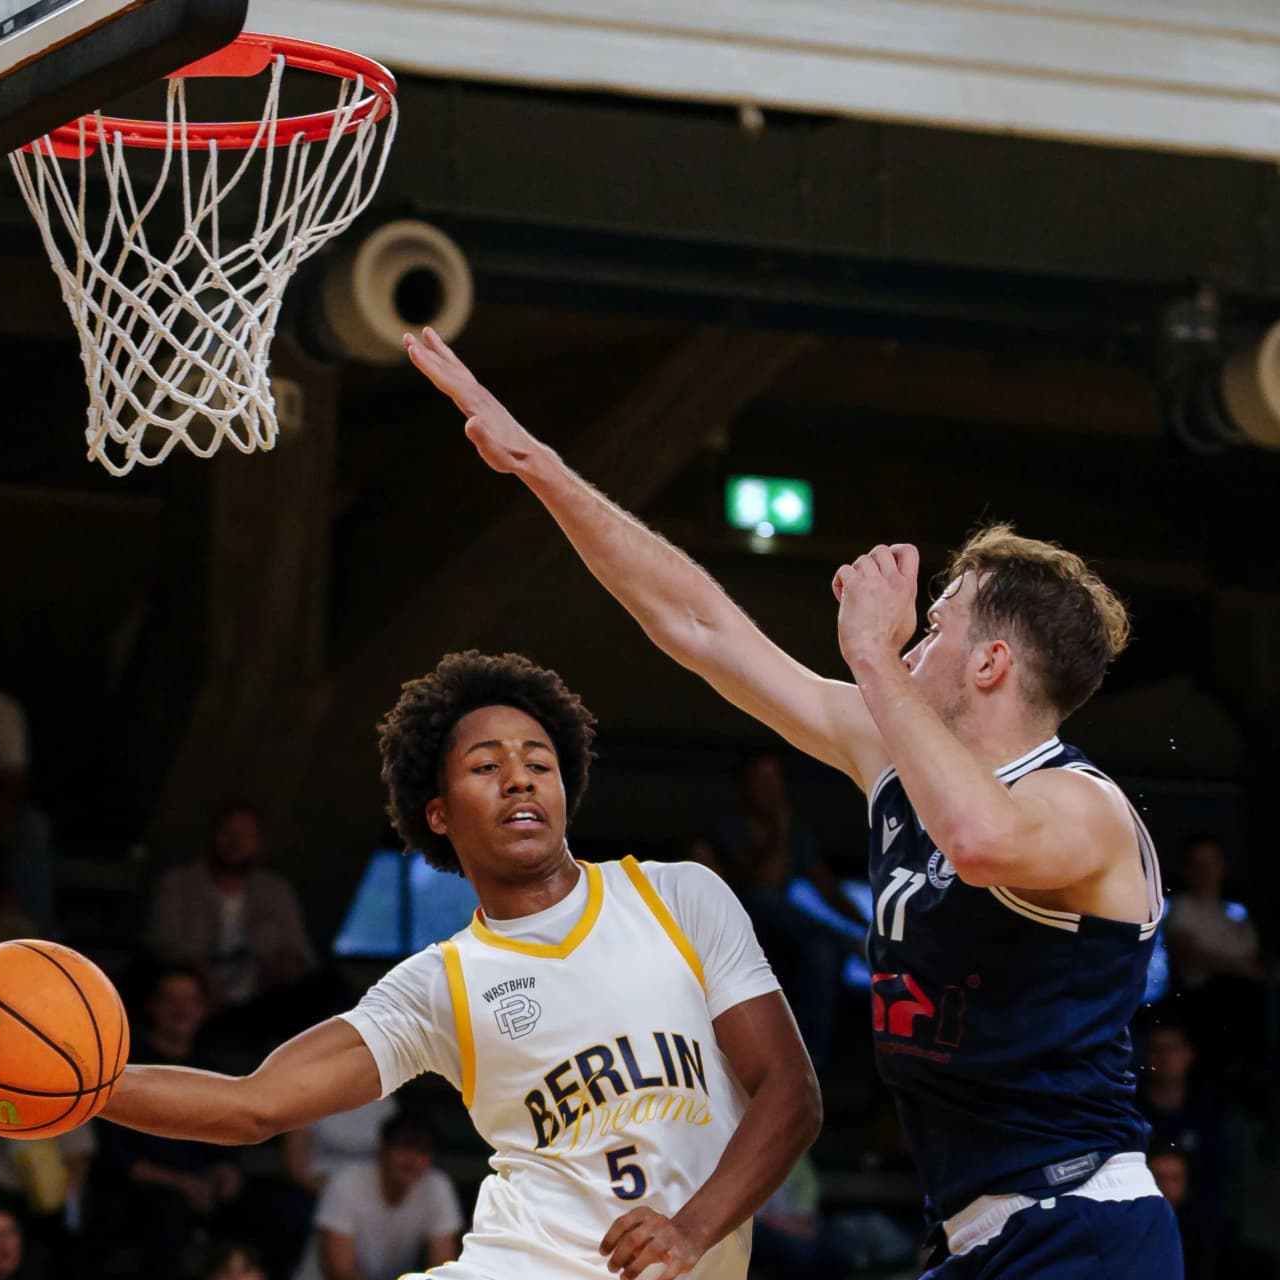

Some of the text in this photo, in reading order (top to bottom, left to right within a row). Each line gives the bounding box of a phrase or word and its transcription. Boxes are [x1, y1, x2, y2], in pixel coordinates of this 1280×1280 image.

[876, 866, 927, 942] 11
[481, 976, 536, 1003] WRSTBHVR
[524, 1031, 710, 1150] BERLIN
[540, 1071, 714, 1159] Dreams
[604, 1143, 648, 1201] 5
